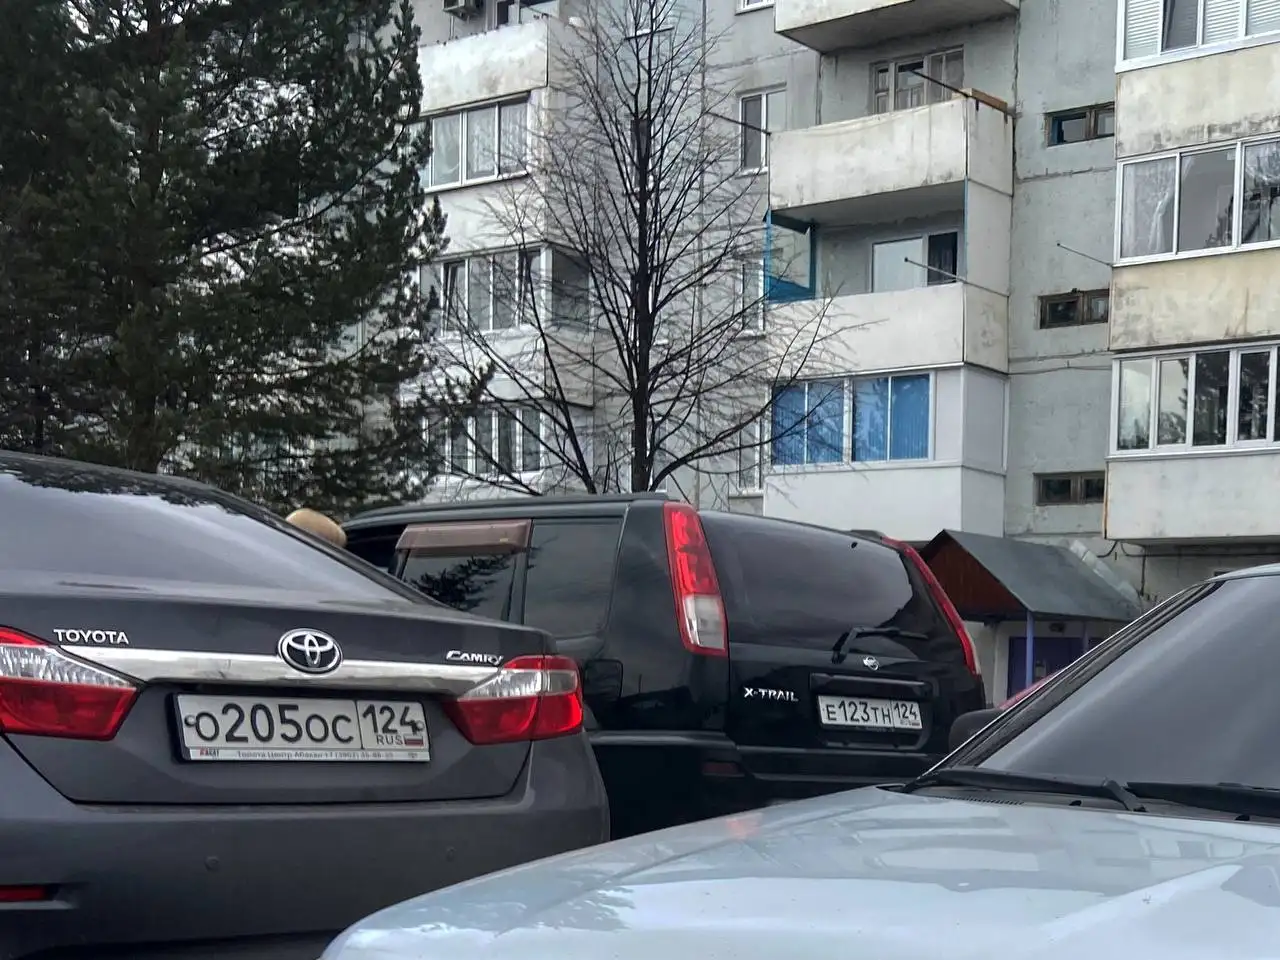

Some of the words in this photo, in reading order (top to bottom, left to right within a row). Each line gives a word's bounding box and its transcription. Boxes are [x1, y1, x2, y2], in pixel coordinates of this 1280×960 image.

[53, 628, 130, 645] TOYOTA
[743, 687, 799, 702] X-TRAIL
[361, 703, 418, 734] 124
[825, 700, 892, 725] Е123ТН
[894, 702, 917, 720] 124
[376, 734, 403, 746] RUS
